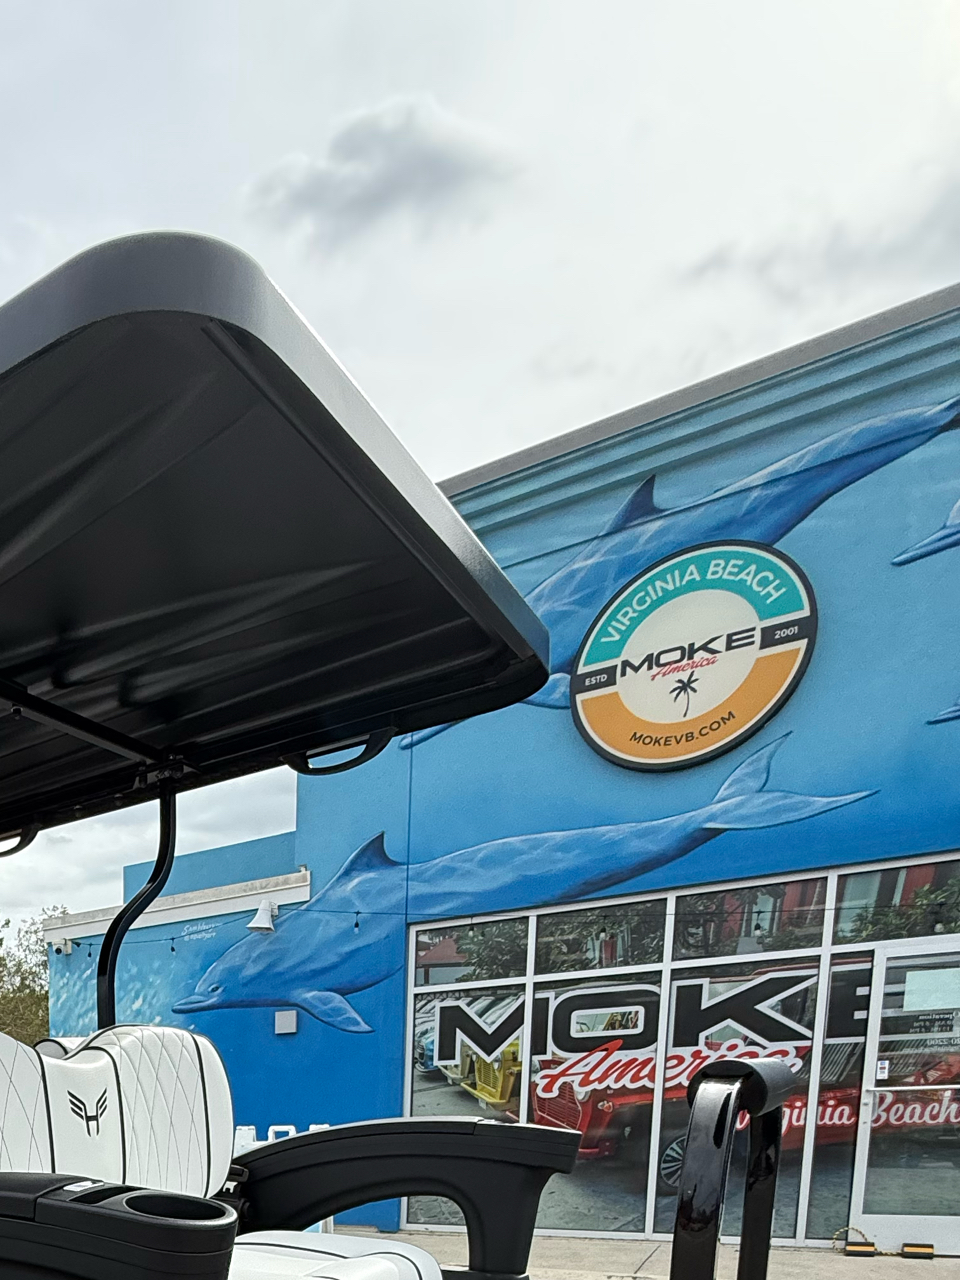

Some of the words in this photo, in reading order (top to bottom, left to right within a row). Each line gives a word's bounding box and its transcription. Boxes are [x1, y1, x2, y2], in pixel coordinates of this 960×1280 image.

[600, 565, 701, 643] VIRGINIA
[706, 558, 787, 604] BEACH
[774, 625, 799, 639] 2001
[620, 626, 757, 678] MOKE
[650, 654, 720, 681] America
[584, 673, 608, 687] ESTD
[629, 710, 737, 747] MOKEVB.COM
[433, 957, 960, 1066] MOKE
[533, 1037, 804, 1098] Amer
[872, 1089, 960, 1128] Beach
